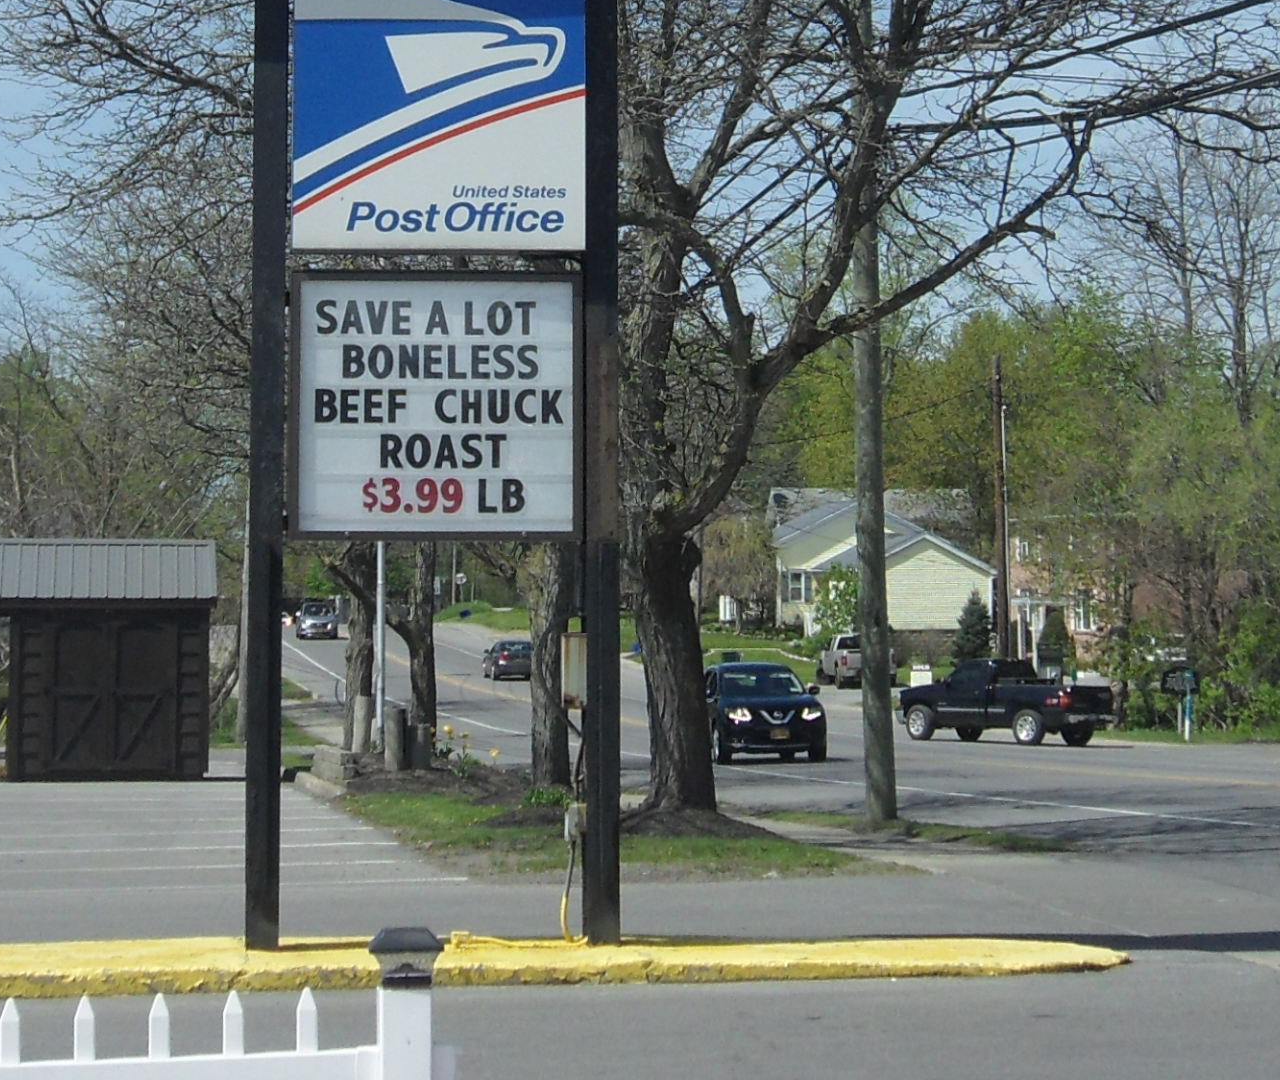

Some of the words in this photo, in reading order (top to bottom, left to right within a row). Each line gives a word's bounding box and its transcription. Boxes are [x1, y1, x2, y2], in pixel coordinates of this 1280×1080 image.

[452, 184, 509, 199] United
[512, 185, 567, 199] States
[346, 201, 440, 233] Post
[444, 201, 565, 233] Office
[315, 299, 412, 335] SAVE
[424, 300, 450, 335] A
[463, 300, 537, 336] LOT
[341, 344, 539, 379] BONELESS
[314, 388, 408, 423] BEEF
[434, 388, 564, 424] CHUCK
[379, 433, 507, 469] ROAST
[361, 476, 464, 513] $3.99
[477, 478, 526, 513] LB
